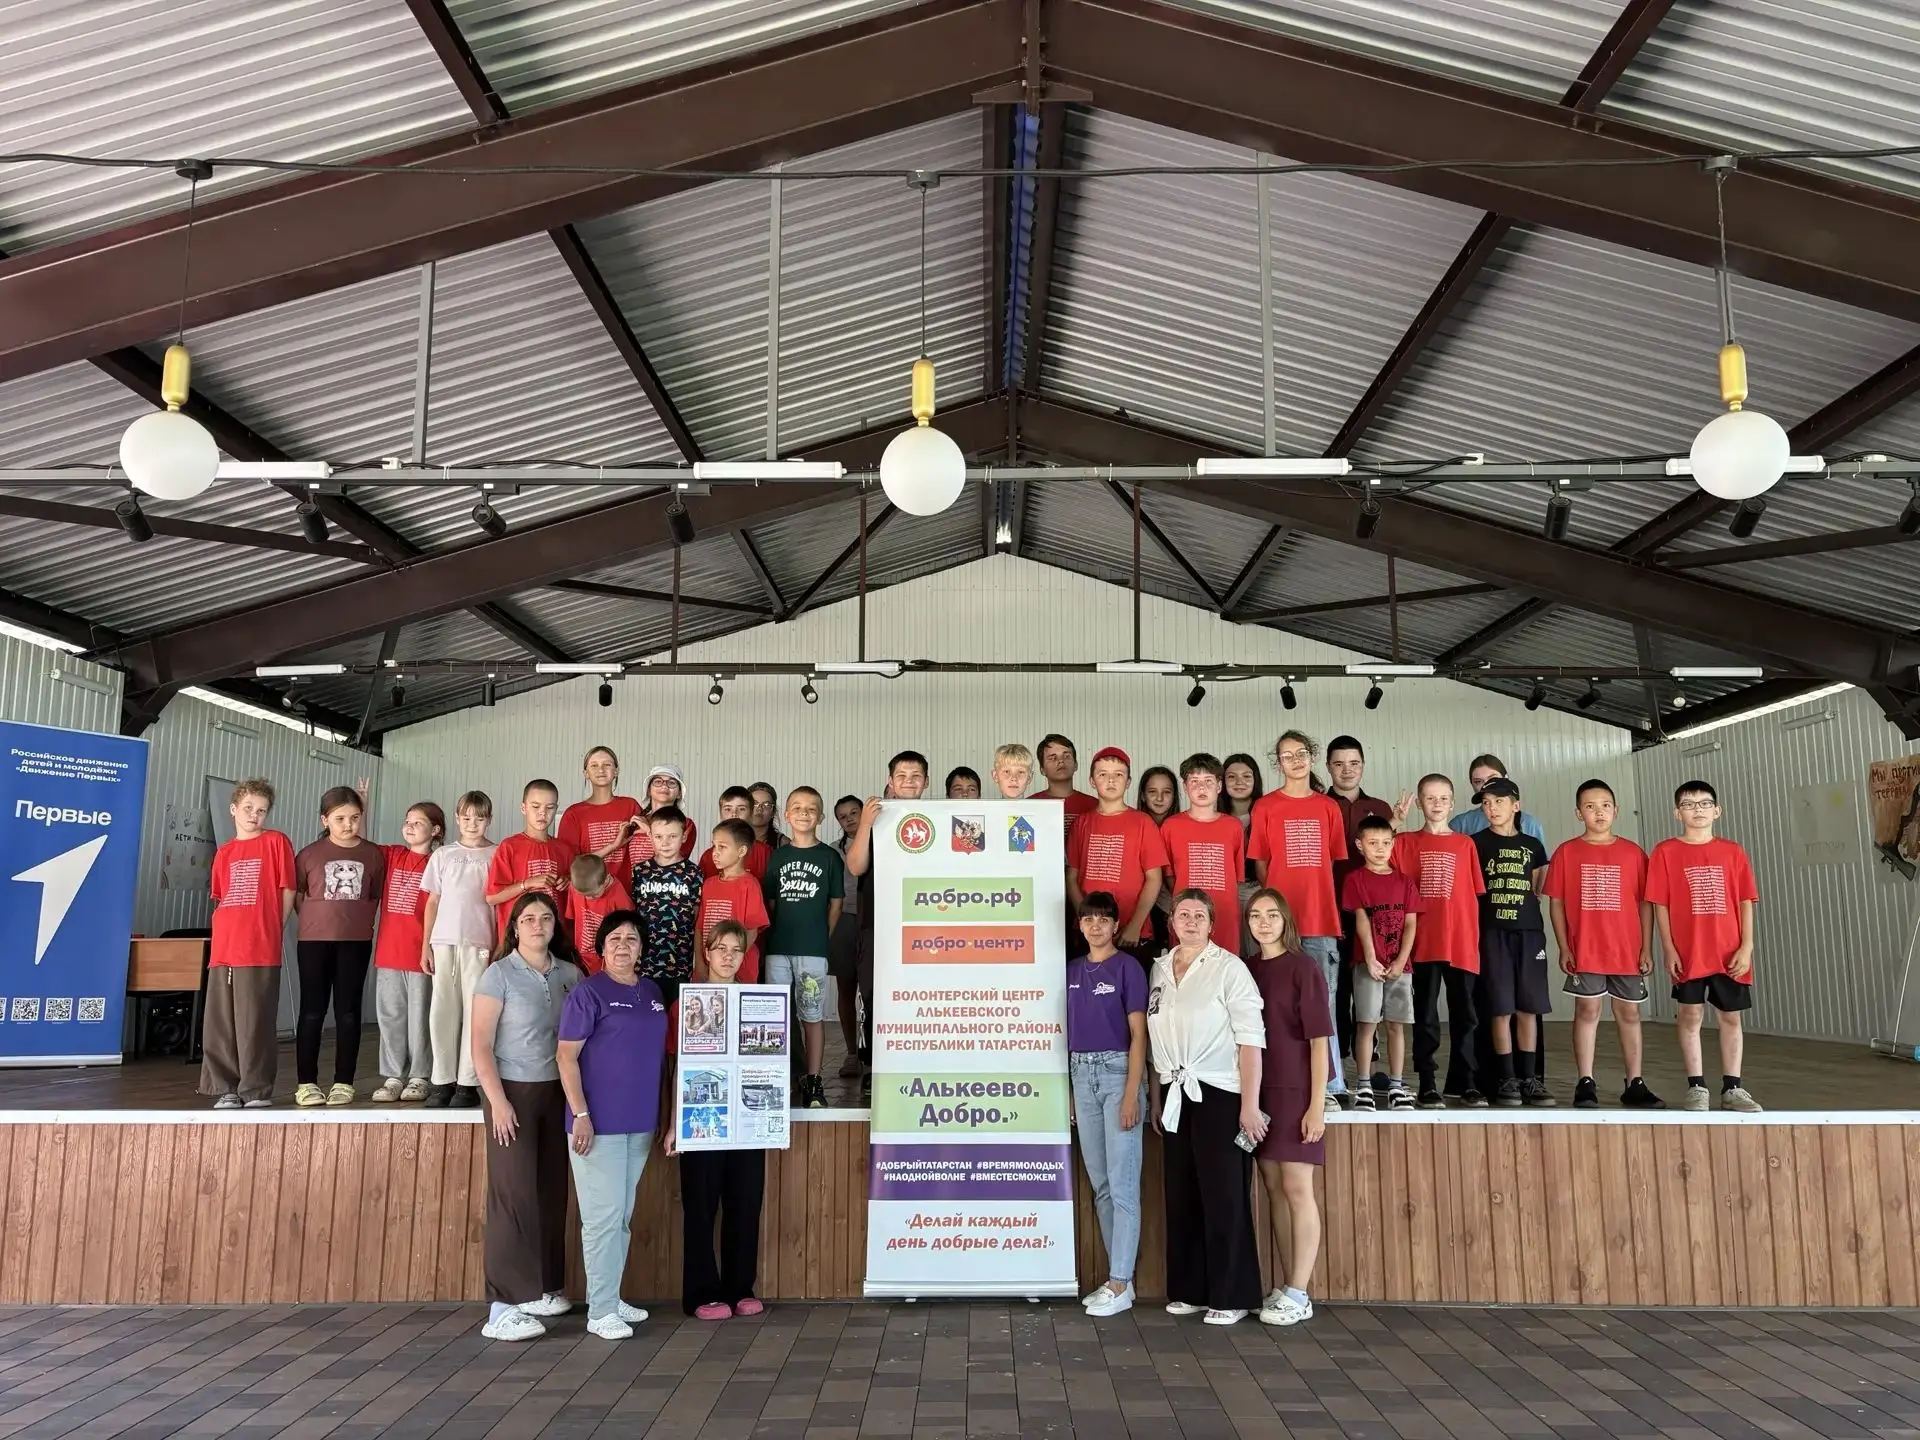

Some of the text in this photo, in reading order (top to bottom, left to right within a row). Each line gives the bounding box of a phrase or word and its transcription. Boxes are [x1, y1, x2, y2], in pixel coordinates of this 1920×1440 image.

[11, 748, 129, 769] Российское движение
[16, 765, 121, 783] «Движение Первых»
[21, 759, 117, 775] детей и молодёжи
[15, 799, 112, 827] Первые
[779, 861, 823, 877] SUPER HARD
[1496, 862, 1525, 875] SKATE
[640, 881, 690, 898] DINOSAUR
[914, 888, 1022, 907] добро.рф
[1491, 893, 1525, 905] HAPPY
[1496, 908, 1518, 920] LIFE
[911, 936, 1025, 951] добро центр
[892, 988, 1045, 1003] ВОЛОНТЕРСКИЙ ЦЕНТР
[916, 1006, 1021, 1018] АЛЬКЕЕВСКОГО
[876, 1020, 1063, 1036] МУНИЦИПАЛЬНОГО РАЙОНА
[886, 1040, 1051, 1051] РЕСПУБЛИКИ ТАТАРСТАН
[899, 1077, 1040, 1098] «Алькеево.
[919, 1102, 1018, 1127] Добро.»
[876, 1161, 1064, 1171] #ДОБРЫЙТАТАРСТАН #ВРЕМЯМОЛОДЫХ
[883, 1172, 1056, 1182] #НАОДНОЙВОЛНЕ #ВМЕСТЕСМОЖЕМ
[904, 1212, 1038, 1229] «Делай каждый
[886, 1234, 1055, 1251] день добрые дела!»
